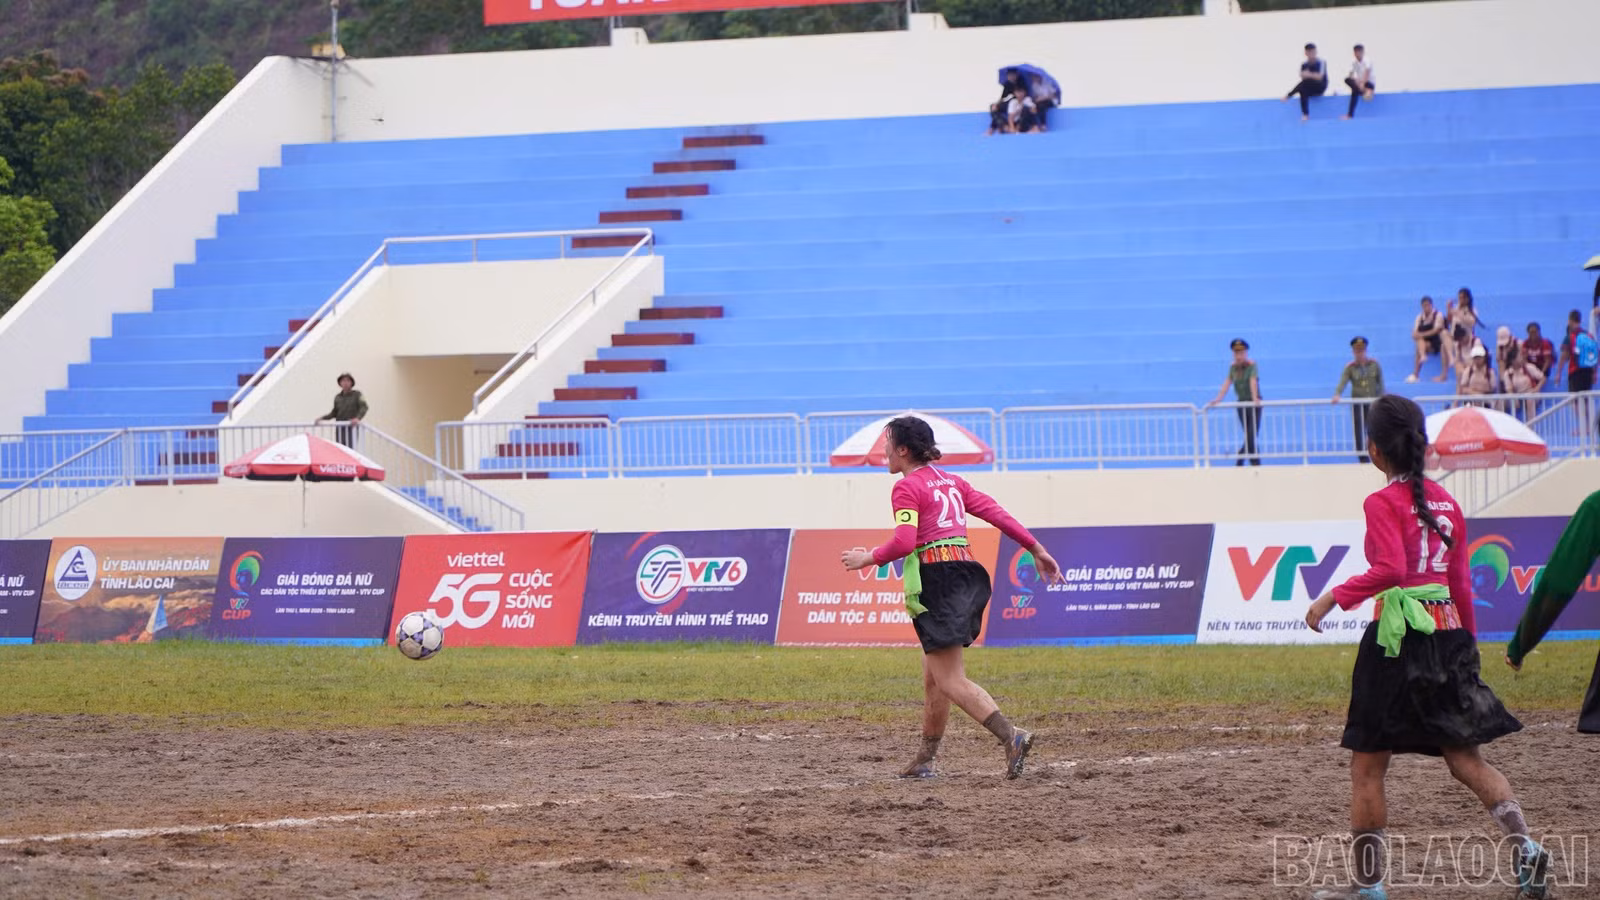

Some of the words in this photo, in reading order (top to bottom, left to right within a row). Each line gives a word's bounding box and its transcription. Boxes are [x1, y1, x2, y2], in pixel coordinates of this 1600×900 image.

[319, 464, 357, 474] viettel
[934, 487, 966, 528] 20
[1417, 515, 1454, 574] 12
[102, 557, 120, 571] ỦY
[120, 560, 146, 571] BAN
[146, 557, 184, 571] NHÂN
[184, 557, 210, 571] DÂN
[447, 551, 506, 567] viettel
[277, 571, 299, 586] GIẢI
[301, 572, 333, 586] BÓNG
[336, 572, 352, 586] ĐÁ
[355, 572, 374, 586] NỮ
[509, 568, 553, 589] CUỘC
[687, 560, 741, 583] VTV6
[1065, 565, 1092, 582] GIẢI
[1095, 565, 1133, 581] BÓNG
[1136, 564, 1155, 580] ĐÁ
[1158, 563, 1181, 579] NỮ
[1227, 545, 1350, 601] VTV
[7, 574, 25, 588] NỮ
[100, 575, 127, 589] TỈNH
[128, 575, 153, 589] LÀO
[153, 577, 175, 589] CAI
[1143, 582, 1160, 590] NAM
[1165, 581, 1179, 589] VTV
[1179, 580, 1194, 589] CUP
[341, 588, 356, 596] NAM
[359, 588, 372, 596] VTV
[372, 588, 385, 596] CUP
[505, 587, 553, 609] SỐNG
[797, 592, 842, 605] TRUNG
[845, 590, 873, 605] TÂM
[229, 598, 249, 609] VTV
[426, 572, 504, 629] 5G
[1010, 595, 1034, 608] VTV
[222, 609, 252, 620] CUP
[502, 610, 535, 629] MỚI
[588, 613, 622, 627] KÊNH
[625, 612, 673, 626] TRUYỀN
[675, 612, 706, 626] HÌNH
[736, 613, 769, 626] THAO
[808, 608, 836, 624] DÂN
[840, 608, 864, 626] TỘC
[1002, 607, 1037, 620] CUP
[1206, 619, 1230, 631] NỀN
[1266, 619, 1308, 631] TRUYỀN
[1318, 619, 1339, 630] ÌNH
[1342, 618, 1357, 630] SỐ
